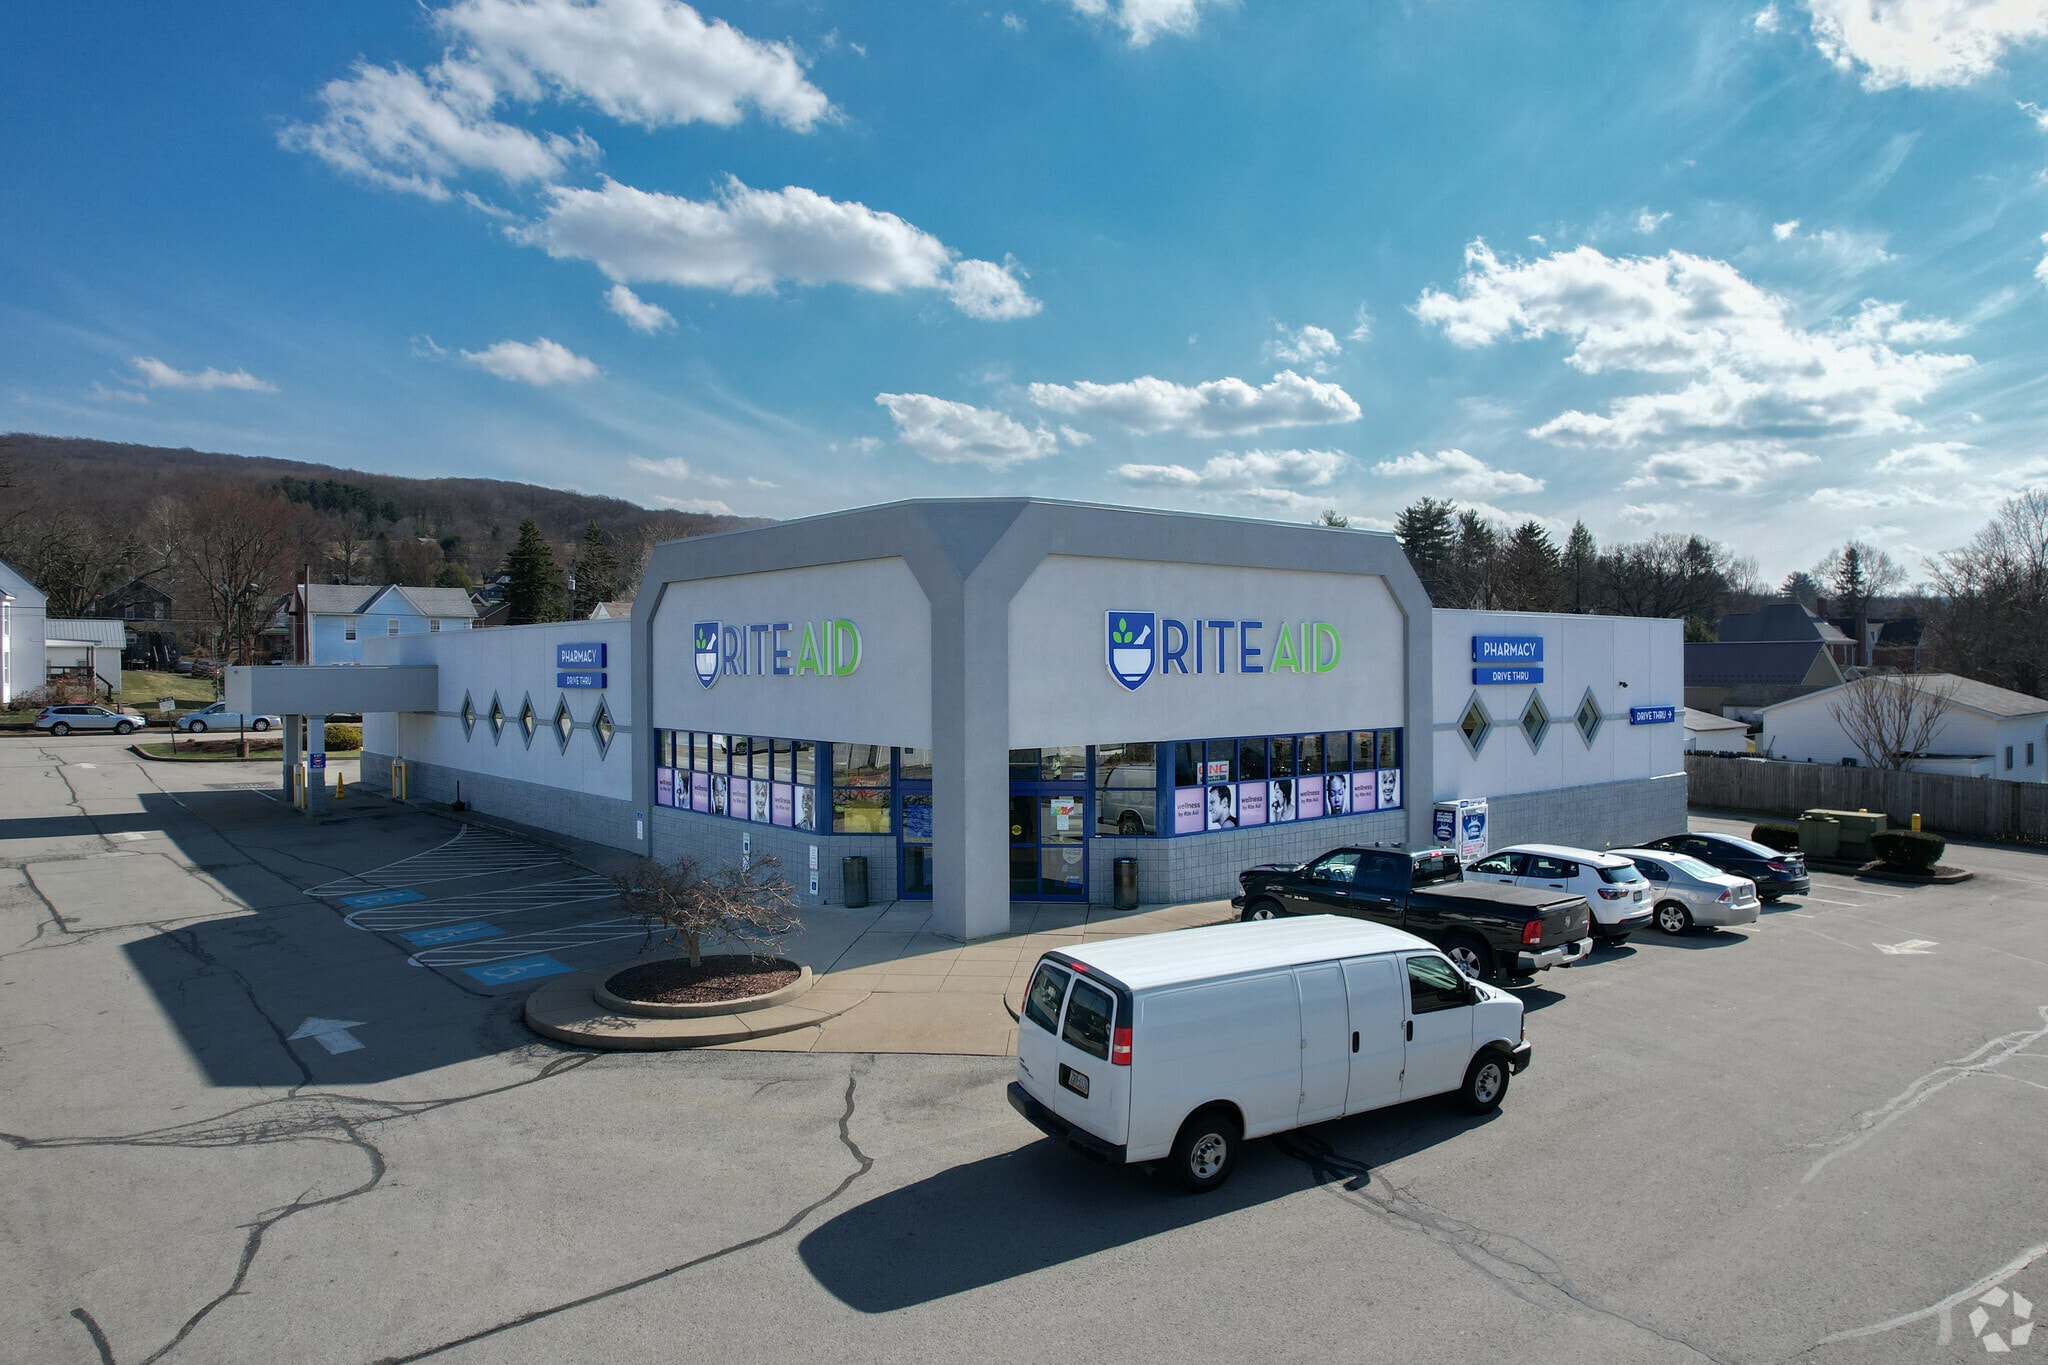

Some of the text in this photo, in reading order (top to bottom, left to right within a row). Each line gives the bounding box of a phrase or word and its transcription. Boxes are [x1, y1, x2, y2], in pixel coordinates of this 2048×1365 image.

[723, 619, 862, 676] RITE AID
[1160, 619, 1341, 674] RITE AID
[1484, 642, 1536, 657] PHARMACY
[561, 649, 597, 663] PHARMACY
[1492, 671, 1530, 681] DRIVE THRU
[1636, 710, 1667, 721] DRIVE THRU
[1177, 801, 1201, 810] wellness
[1241, 796, 1263, 804] wellness
